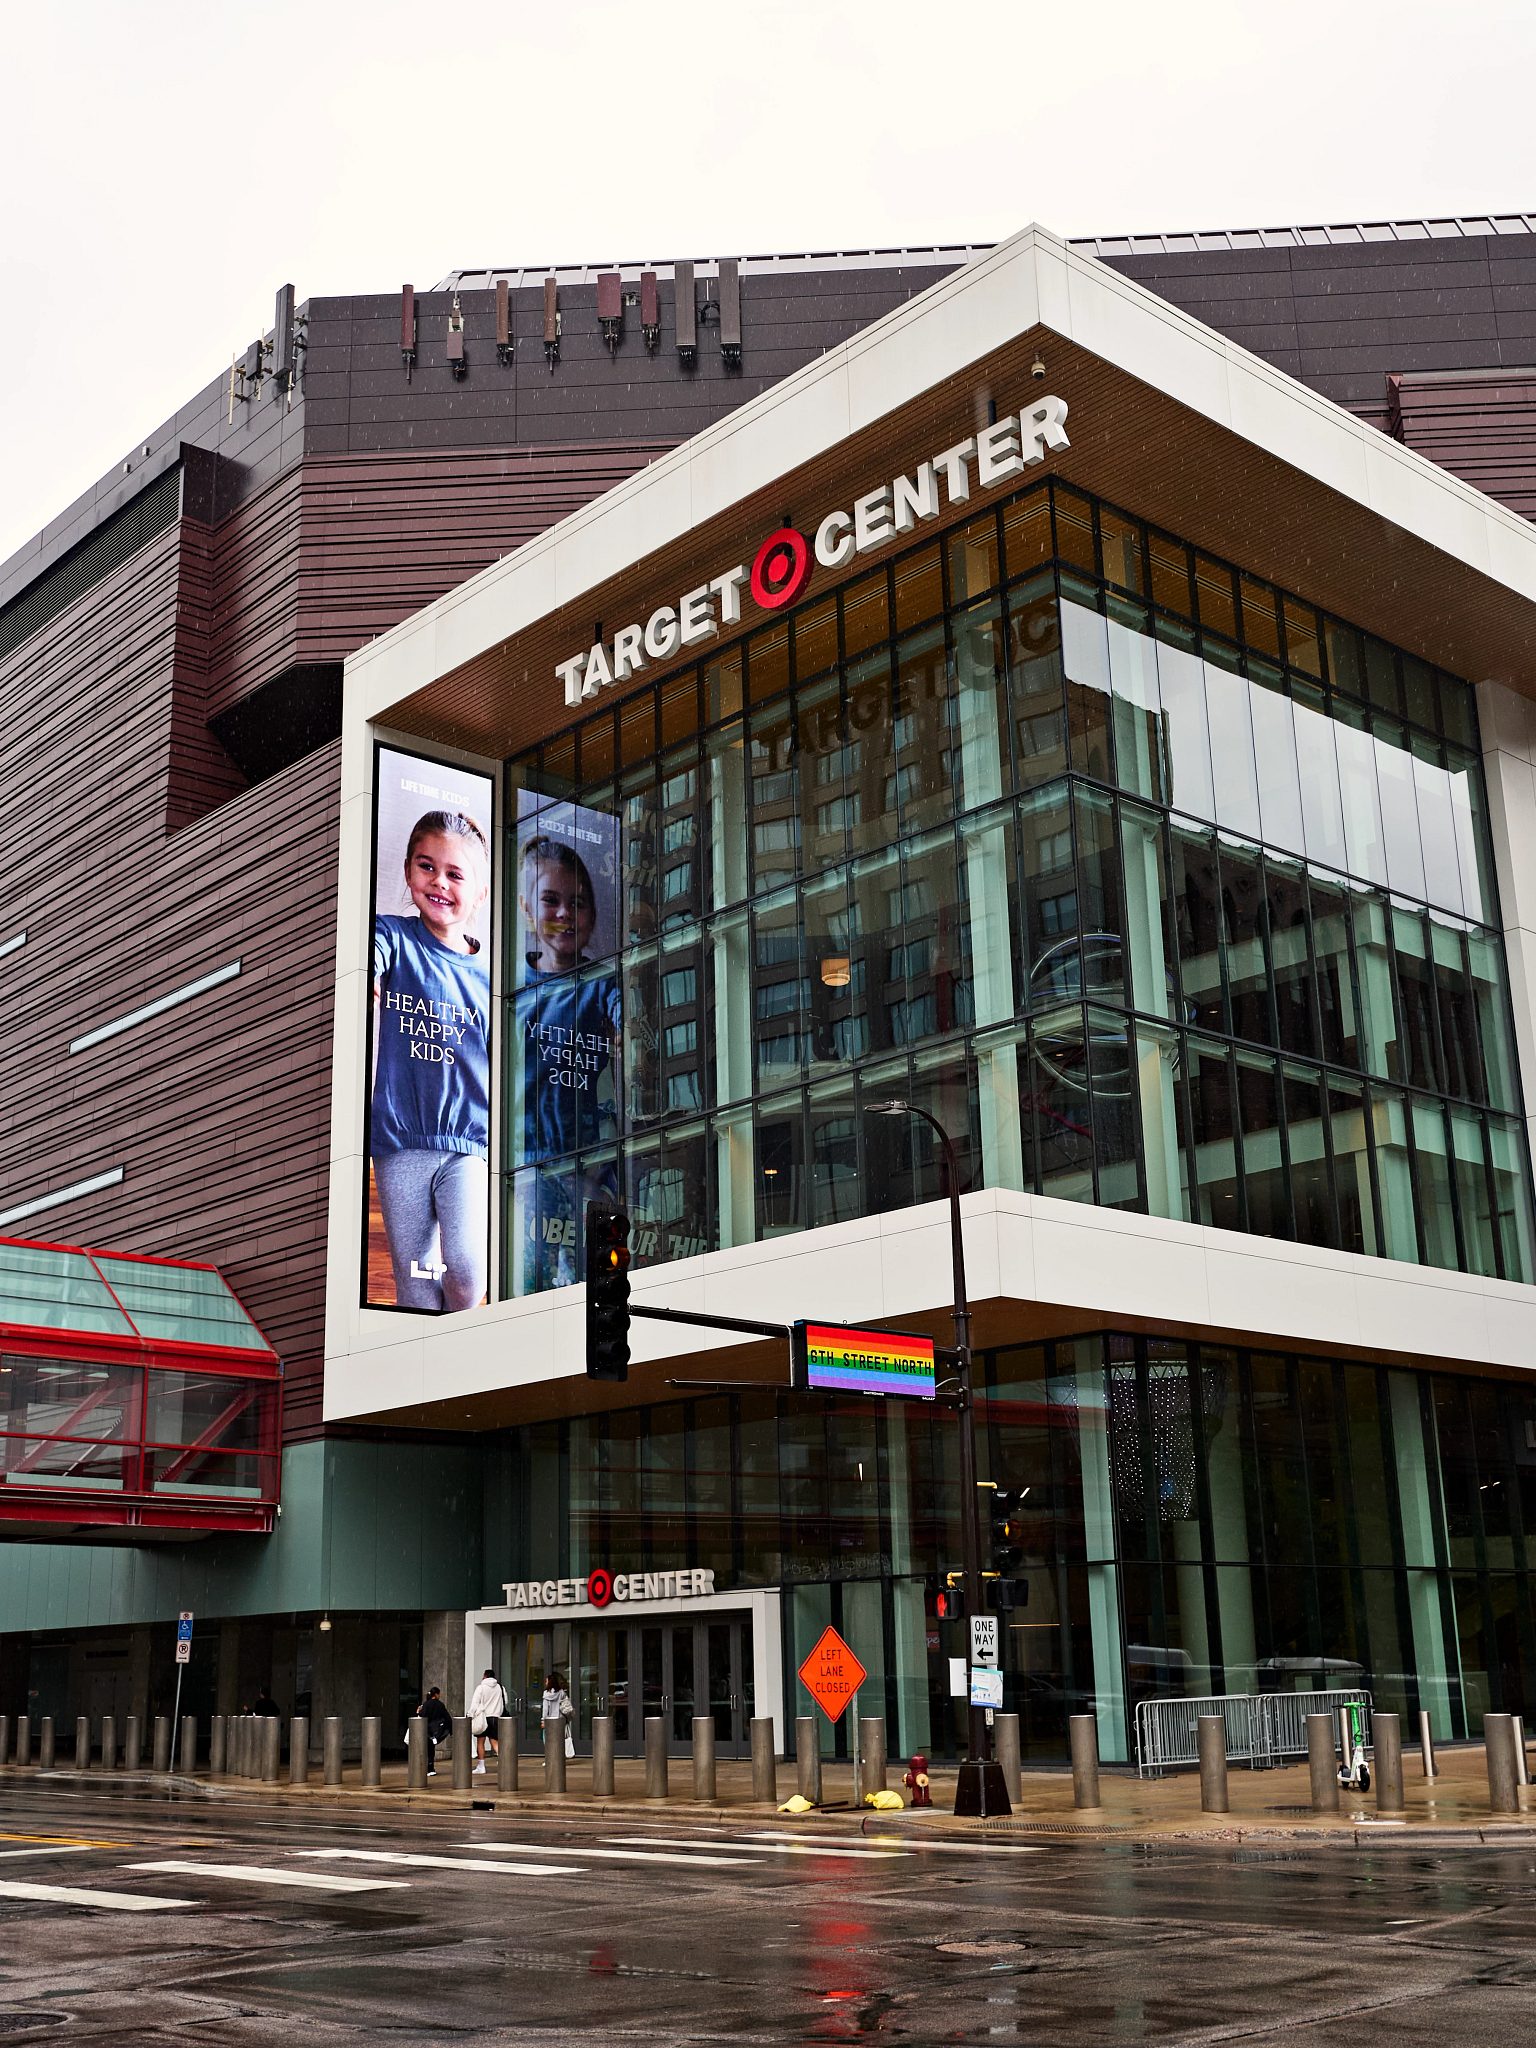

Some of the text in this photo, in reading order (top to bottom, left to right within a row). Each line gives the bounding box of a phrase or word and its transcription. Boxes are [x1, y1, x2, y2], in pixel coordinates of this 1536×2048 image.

[555, 395, 1071, 707] TARGET CENTER
[400, 778, 418, 793] LIFE
[441, 790, 470, 807] KIDS
[385, 990, 479, 1026] HEALTHY
[399, 1015, 467, 1045] HAPPY
[409, 1040, 455, 1065] KIDS
[530, 1216, 587, 1248] OBE
[810, 1349, 932, 1376] 6TH STREET NORTH
[502, 1568, 715, 1608] TARGET CENTER
[974, 1620, 994, 1632] ONE
[974, 1633, 995, 1646] WAY
[820, 1649, 842, 1660] LEFT
[820, 1665, 844, 1677] LANE
[815, 1682, 850, 1693] CLOSED
